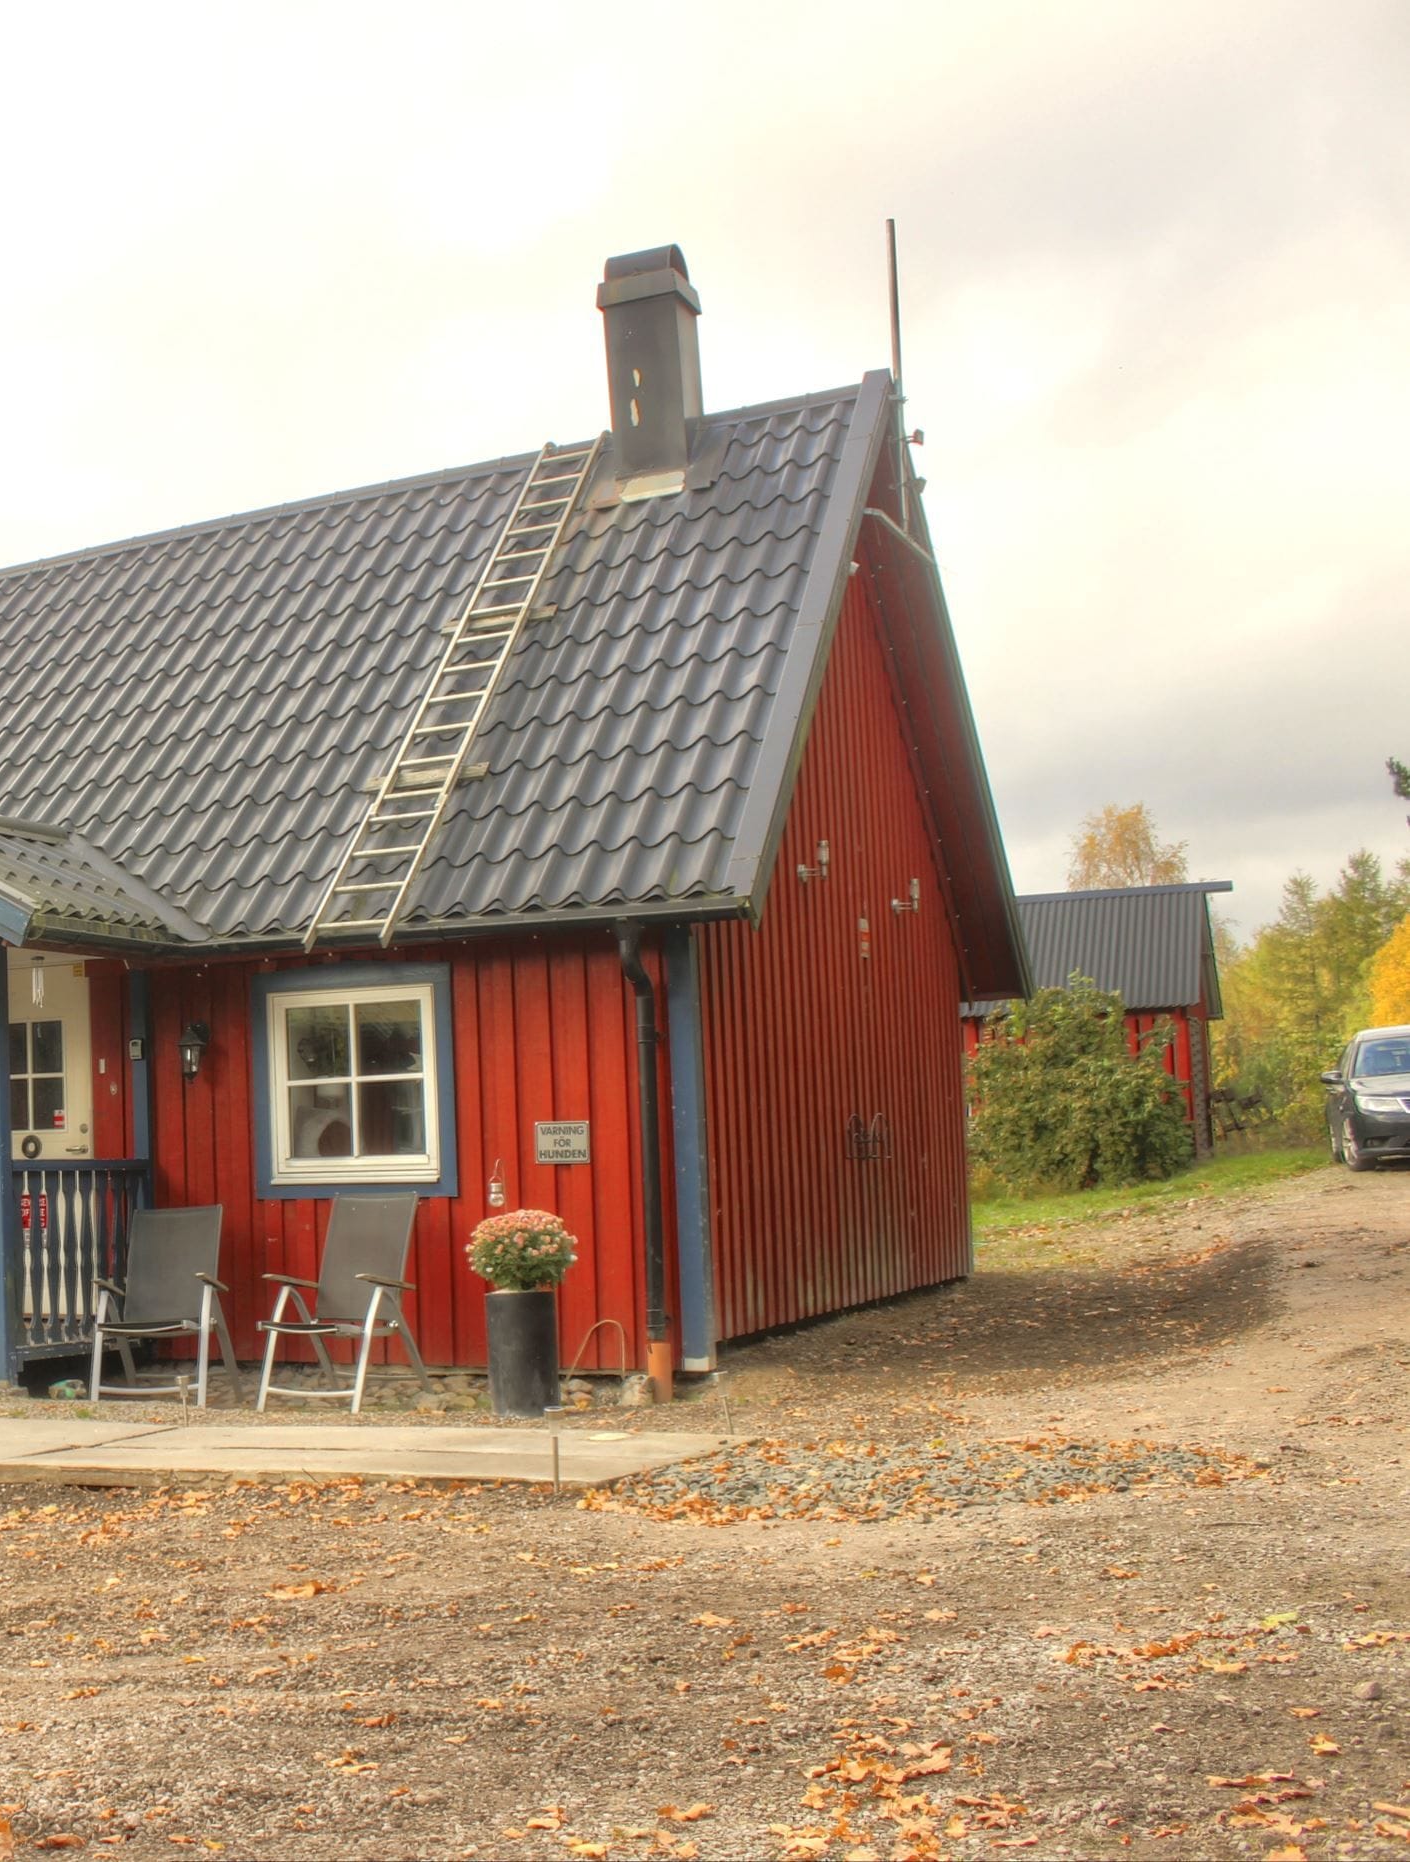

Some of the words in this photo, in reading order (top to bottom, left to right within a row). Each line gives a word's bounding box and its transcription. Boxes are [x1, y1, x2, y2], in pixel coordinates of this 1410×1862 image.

[540, 1126, 584, 1135] VARNING
[553, 1136, 571, 1147] FÖR
[539, 1150, 587, 1159] HUNDEN
